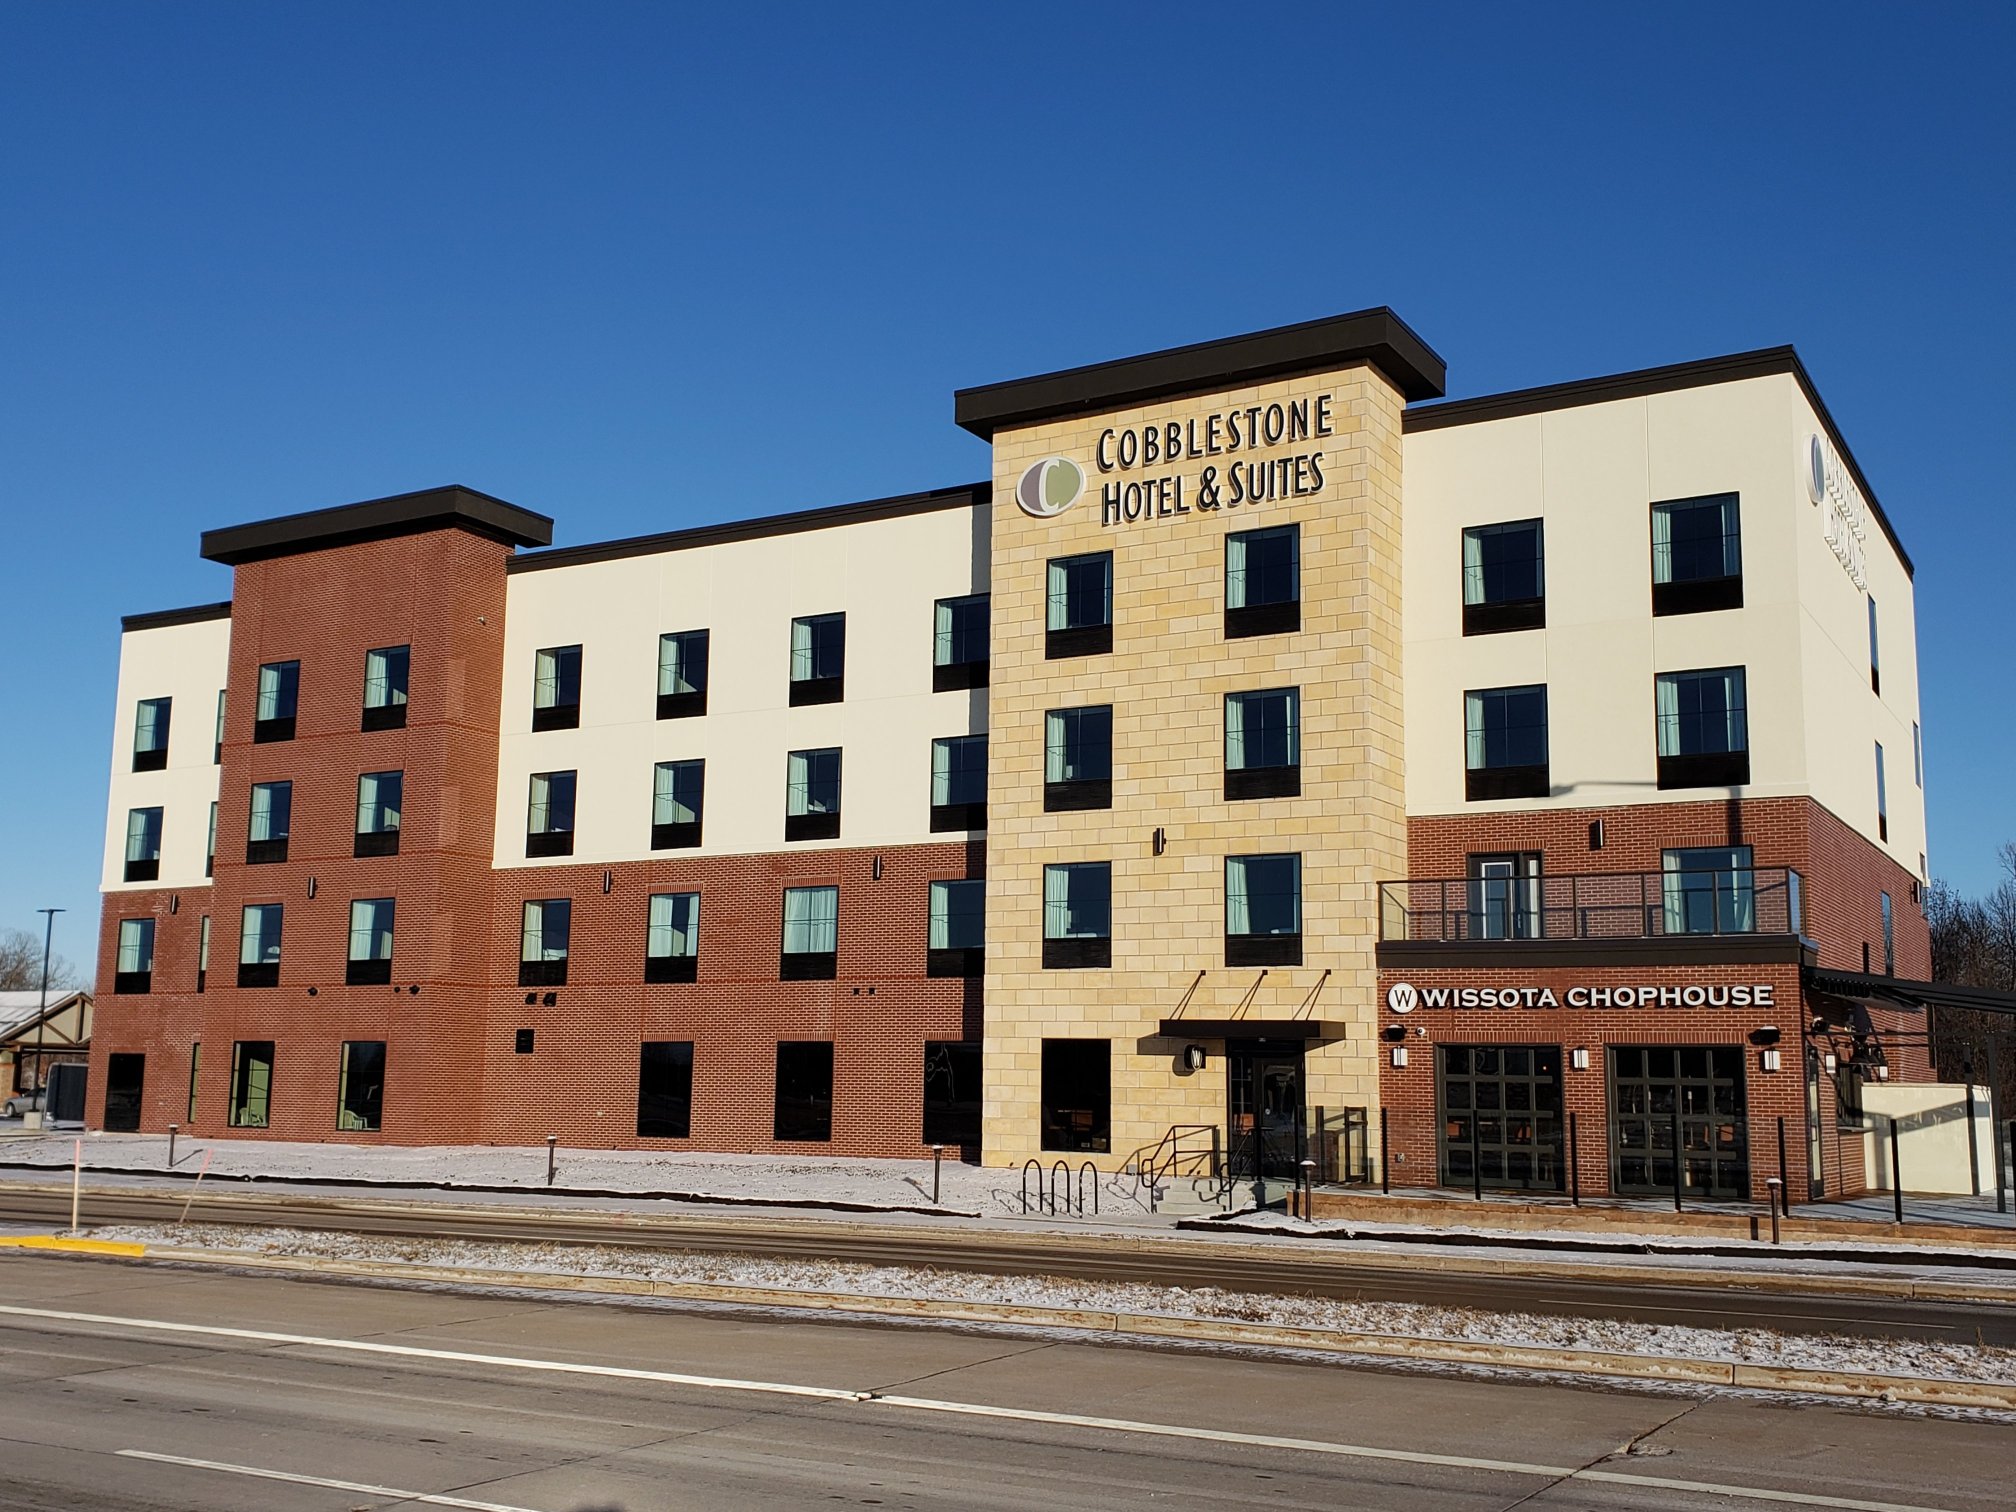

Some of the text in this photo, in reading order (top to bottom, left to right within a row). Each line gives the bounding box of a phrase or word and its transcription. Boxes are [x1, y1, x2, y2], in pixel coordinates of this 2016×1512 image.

[1098, 395, 1332, 471] COBBLESTONE
[1102, 452, 1325, 524] HOTEL & SUITES
[1394, 985, 1774, 1007] W WISSOTA CHOPHOUSE
